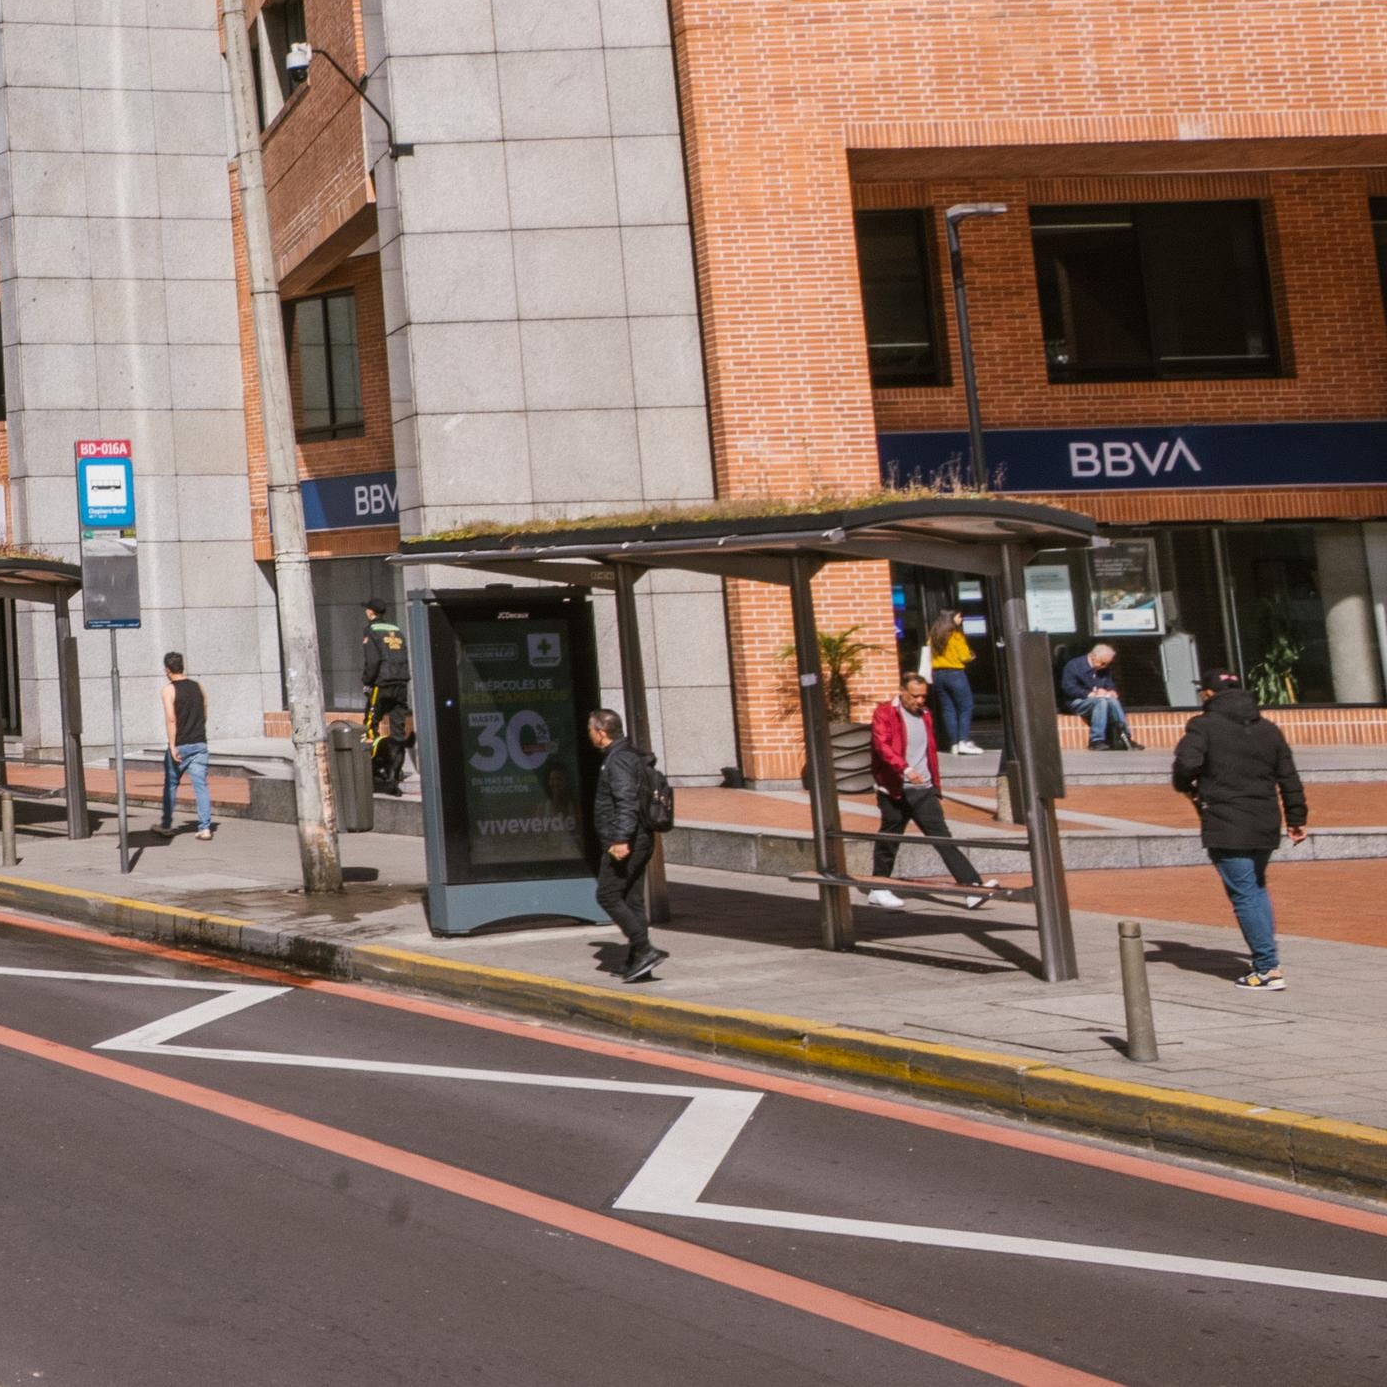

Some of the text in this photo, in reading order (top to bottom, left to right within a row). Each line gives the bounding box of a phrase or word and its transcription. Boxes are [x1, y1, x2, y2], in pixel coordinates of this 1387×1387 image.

[80, 442, 128, 455] BD-016A
[1068, 437, 1202, 477] BBVA
[354, 483, 398, 516] BBV
[468, 709, 551, 772] 30
[477, 812, 576, 835] viveverde
